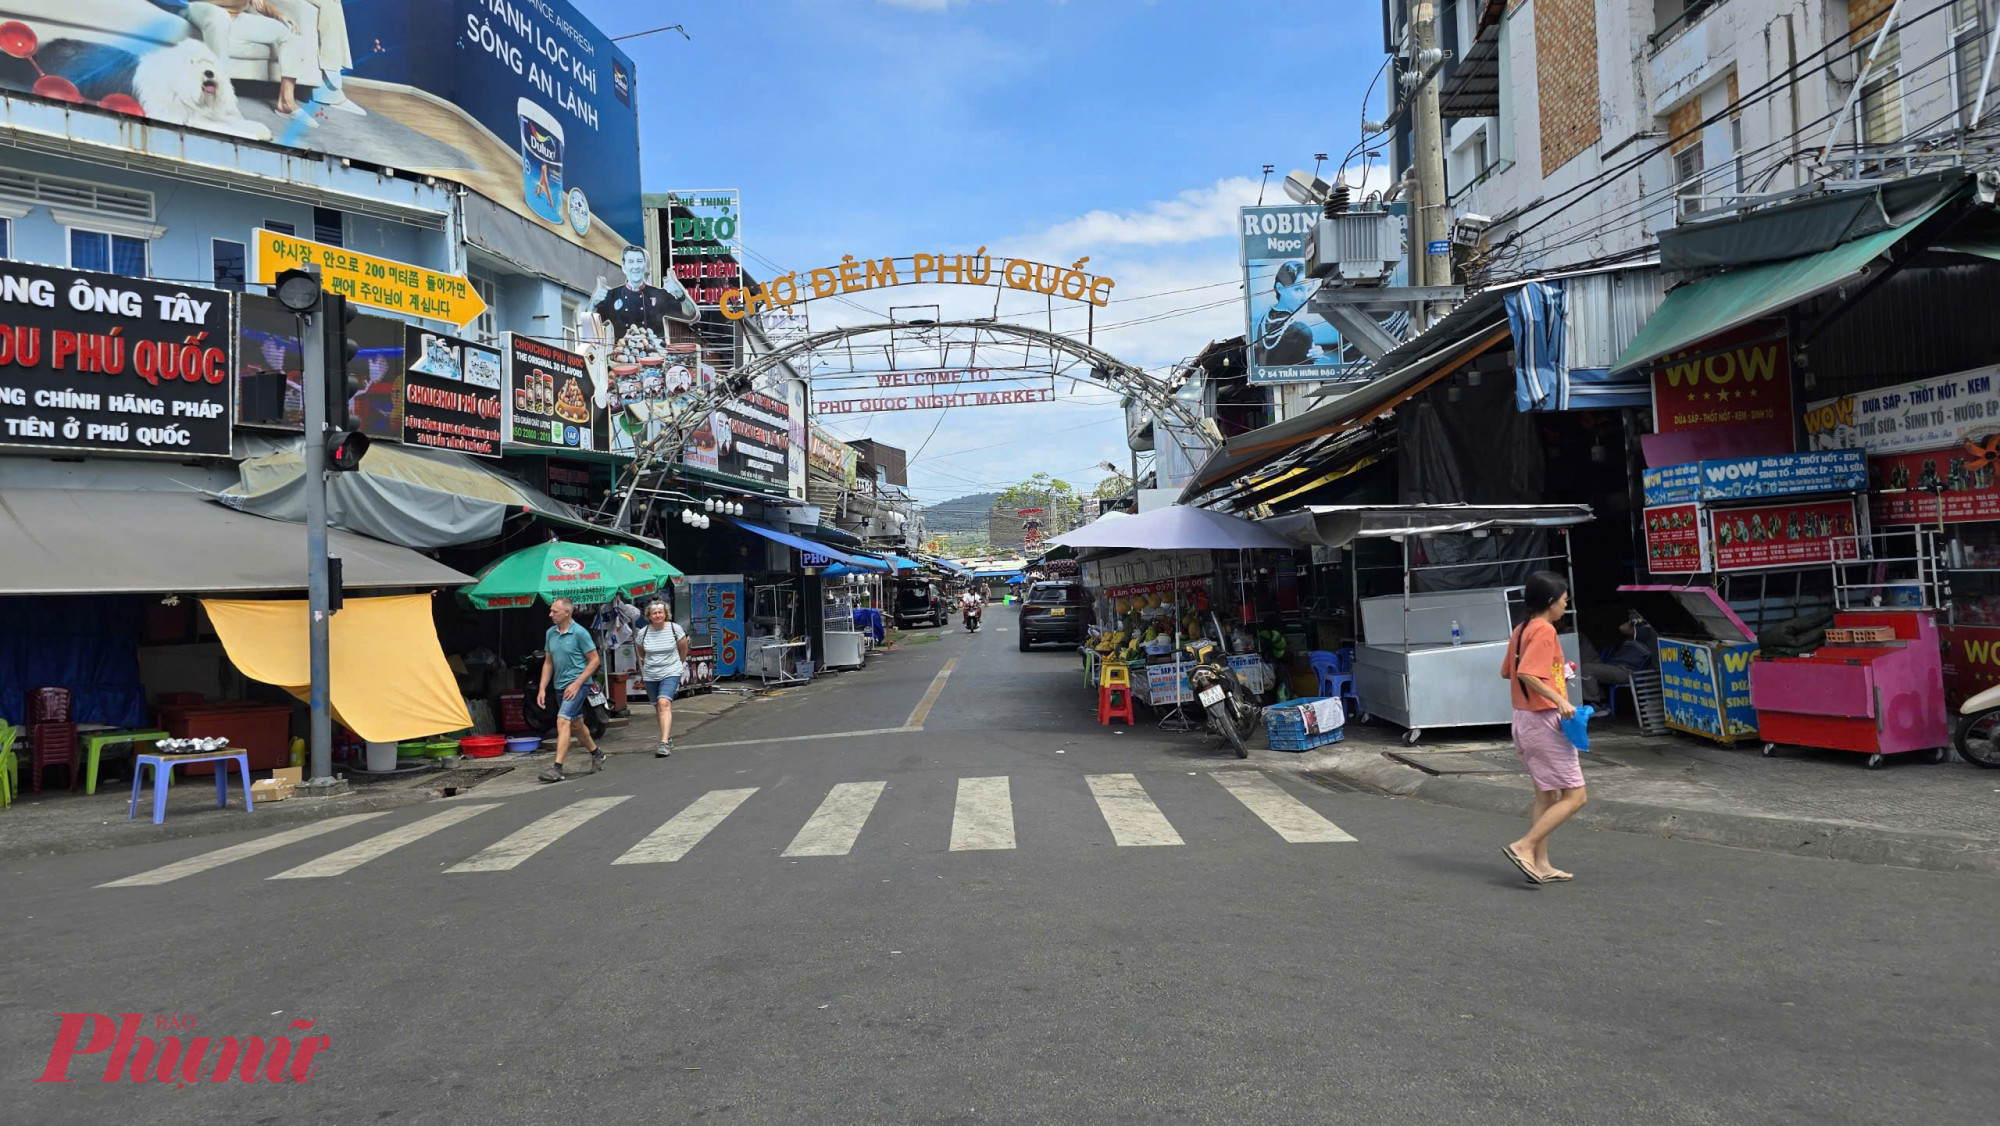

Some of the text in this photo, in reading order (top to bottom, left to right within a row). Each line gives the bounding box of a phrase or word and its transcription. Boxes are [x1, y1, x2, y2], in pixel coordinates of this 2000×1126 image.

[556, 16, 595, 58] AIRFRESH
[467, 13, 599, 131] SỐNG AN LÀNH
[536, 27, 569, 72] LỌC
[572, 56, 597, 95] KHÍ
[530, 135, 555, 160] Dulux
[700, 197, 731, 209] THỊNH
[672, 206, 738, 242] PHỞ
[272, 239, 312, 263] 야시장
[322, 250, 359, 273] 안으로
[364, 262, 385, 278] 200
[677, 246, 702, 255] NAM
[1267, 237, 1302, 252] Ngọc
[674, 259, 737, 282] CHỢ ĐÊM
[719, 246, 1115, 321] CHỢ ĐÊM PHÚ QUỐC
[0, 275, 212, 325] NG ÔNG TÂY
[331, 276, 356, 297] 편에
[359, 282, 402, 306] 주인님이
[409, 293, 450, 318] 계십니다
[52, 326, 125, 375] PHÚ
[133, 331, 226, 386] QUỐC
[514, 338, 552, 358] CHOUCHOU
[515, 351, 528, 361] THE
[527, 354, 553, 370] ORIGINAL
[560, 364, 583, 378] FLAVORS
[876, 368, 991, 388] WELCOME TO
[1267, 370, 1277, 378] 54
[1279, 367, 1298, 378] TRẦN
[1320, 368, 1336, 377] ĐẠO
[1662, 345, 1777, 388] WOW
[34, 388, 101, 411] CHÍNH
[108, 393, 165, 416] HÃNG
[171, 399, 224, 419] PHÁP
[406, 383, 457, 411] CHOUCHOU
[457, 393, 477, 415] PHÚ
[860, 398, 908, 412] QUOC
[915, 393, 968, 410] NIGHT
[976, 388, 1050, 405] MARKET
[1862, 396, 1881, 414] DỪA
[1882, 393, 1901, 410] SÁP
[1967, 375, 1991, 395] KEM
[1803, 396, 1854, 435] WOW
[1905, 413, 1929, 431] SINH
[1986, 399, 2000, 418] ÉP
[4, 416, 191, 446] TIÊN Ở PHÚ QUỐC
[567, 431, 577, 440] IAF
[1643, 471, 1662, 489] WOW
[1706, 460, 1758, 483] WOW
[721, 590, 736, 620] IN
[1130, 586, 1151, 594] Oanh
[721, 627, 740, 665] ÁO
[1661, 647, 1679, 662] WOW
